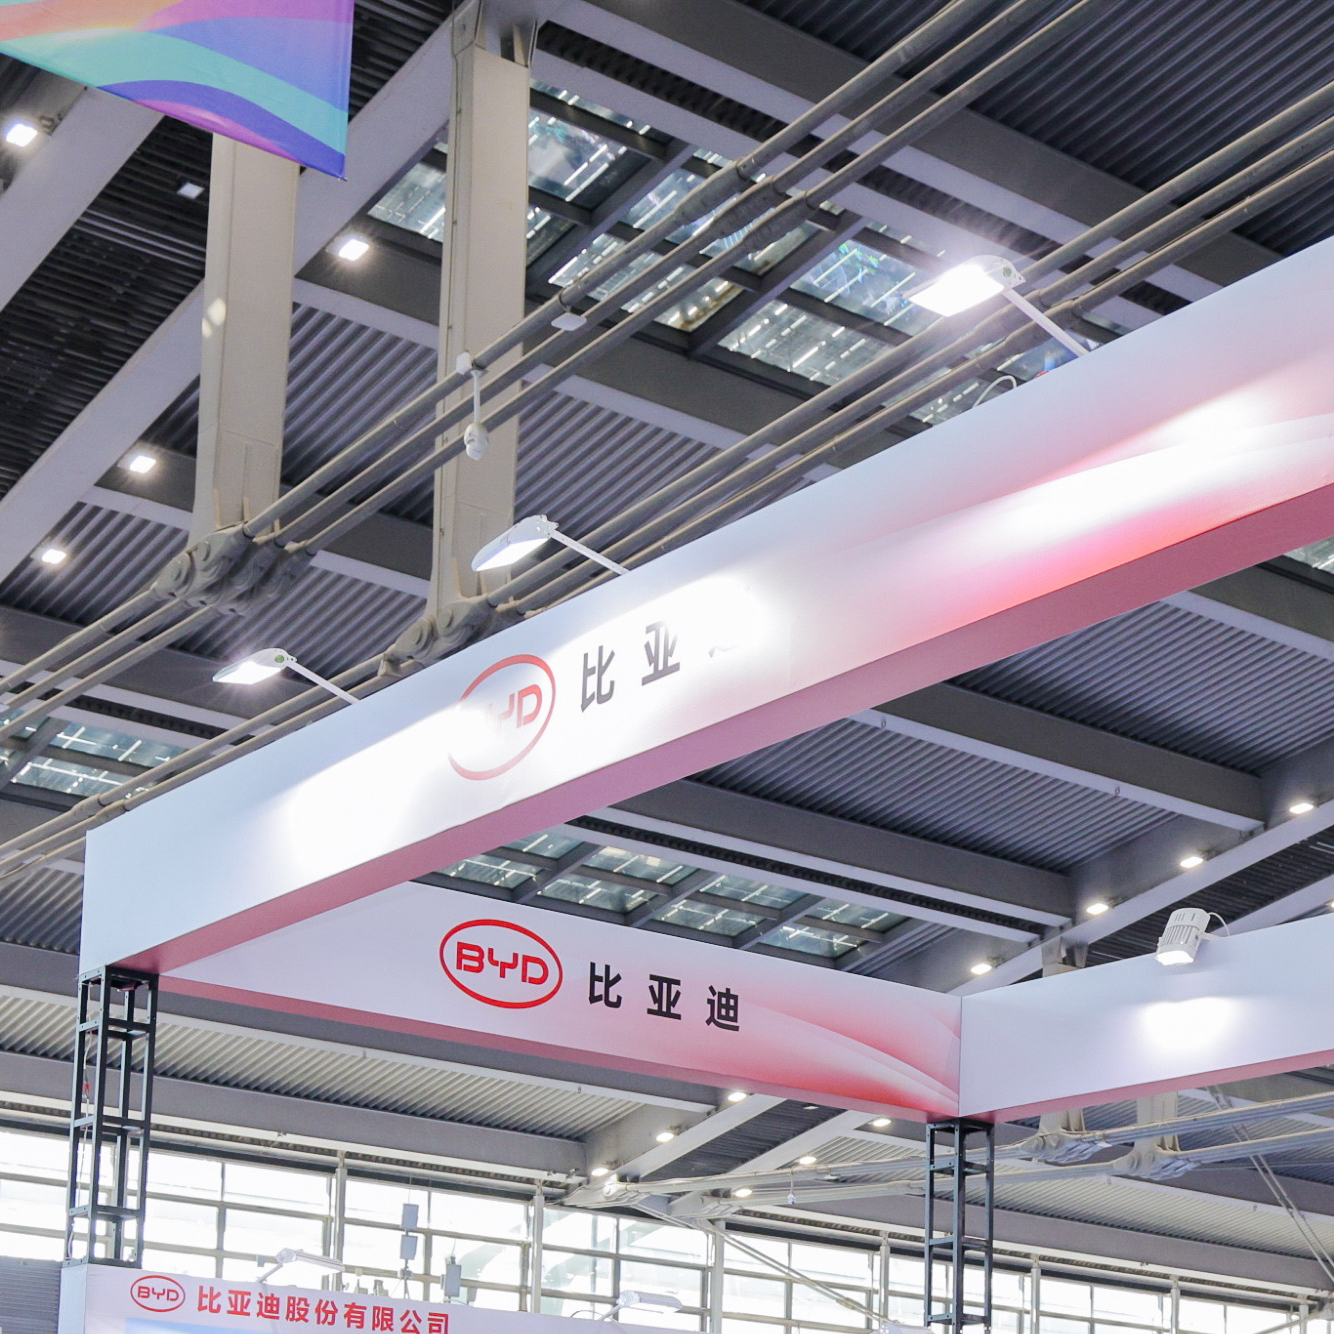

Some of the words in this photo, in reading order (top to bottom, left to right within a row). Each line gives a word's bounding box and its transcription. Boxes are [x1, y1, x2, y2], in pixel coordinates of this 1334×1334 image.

[580, 620, 740, 712] 比亚
[455, 940, 549, 988] BYD
[588, 961, 740, 1032] 比亚迪
[137, 1285, 180, 1303] BYD
